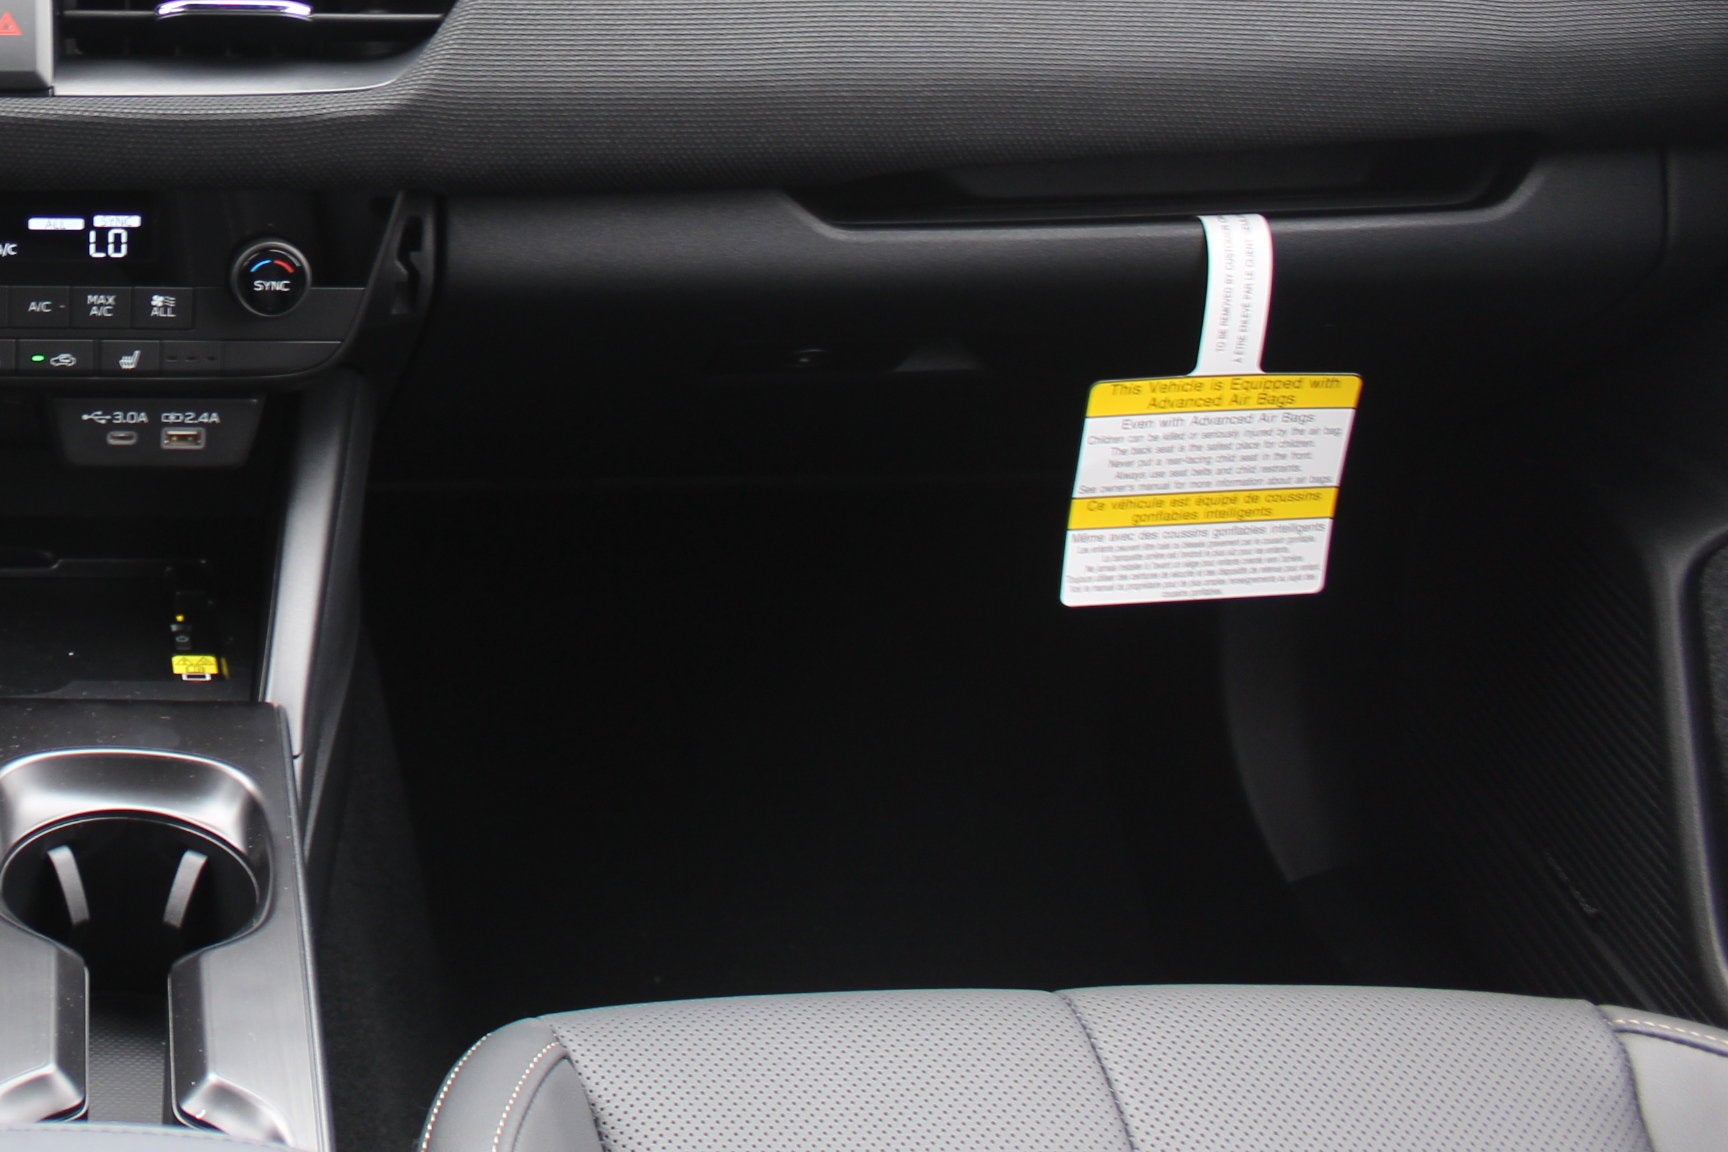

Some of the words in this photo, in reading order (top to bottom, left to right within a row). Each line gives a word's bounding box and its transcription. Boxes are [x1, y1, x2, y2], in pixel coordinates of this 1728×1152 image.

[89, 228, 128, 258] LO
[253, 280, 291, 292] SYNC
[87, 295, 116, 306] MAX
[28, 301, 52, 313] A/C
[89, 306, 114, 317] A/C
[151, 307, 177, 318] ALL
[1111, 383, 1142, 396] This
[1148, 380, 1204, 394] Vehicle
[1211, 380, 1223, 391] is
[1230, 377, 1304, 391] Equipped
[1310, 377, 1341, 389] with
[1147, 396, 1223, 409] Advanced
[1229, 394, 1250, 406] Air
[1256, 392, 1296, 408] Bags
[112, 412, 149, 424] 3.0A
[184, 412, 221, 424] 2.4A
[1120, 418, 1154, 430] Even
[1158, 416, 1184, 428] with
[1189, 413, 1253, 426] Advanced
[1259, 412, 1277, 423] Air
[1281, 412, 1315, 425] Bags
[1087, 500, 1105, 512] Ce
[1169, 496, 1189, 508] est
[1243, 493, 1259, 504] de
[1264, 491, 1322, 503] coussins
[1131, 510, 1199, 526] gonflables
[1203, 506, 1272, 521] intelligents
